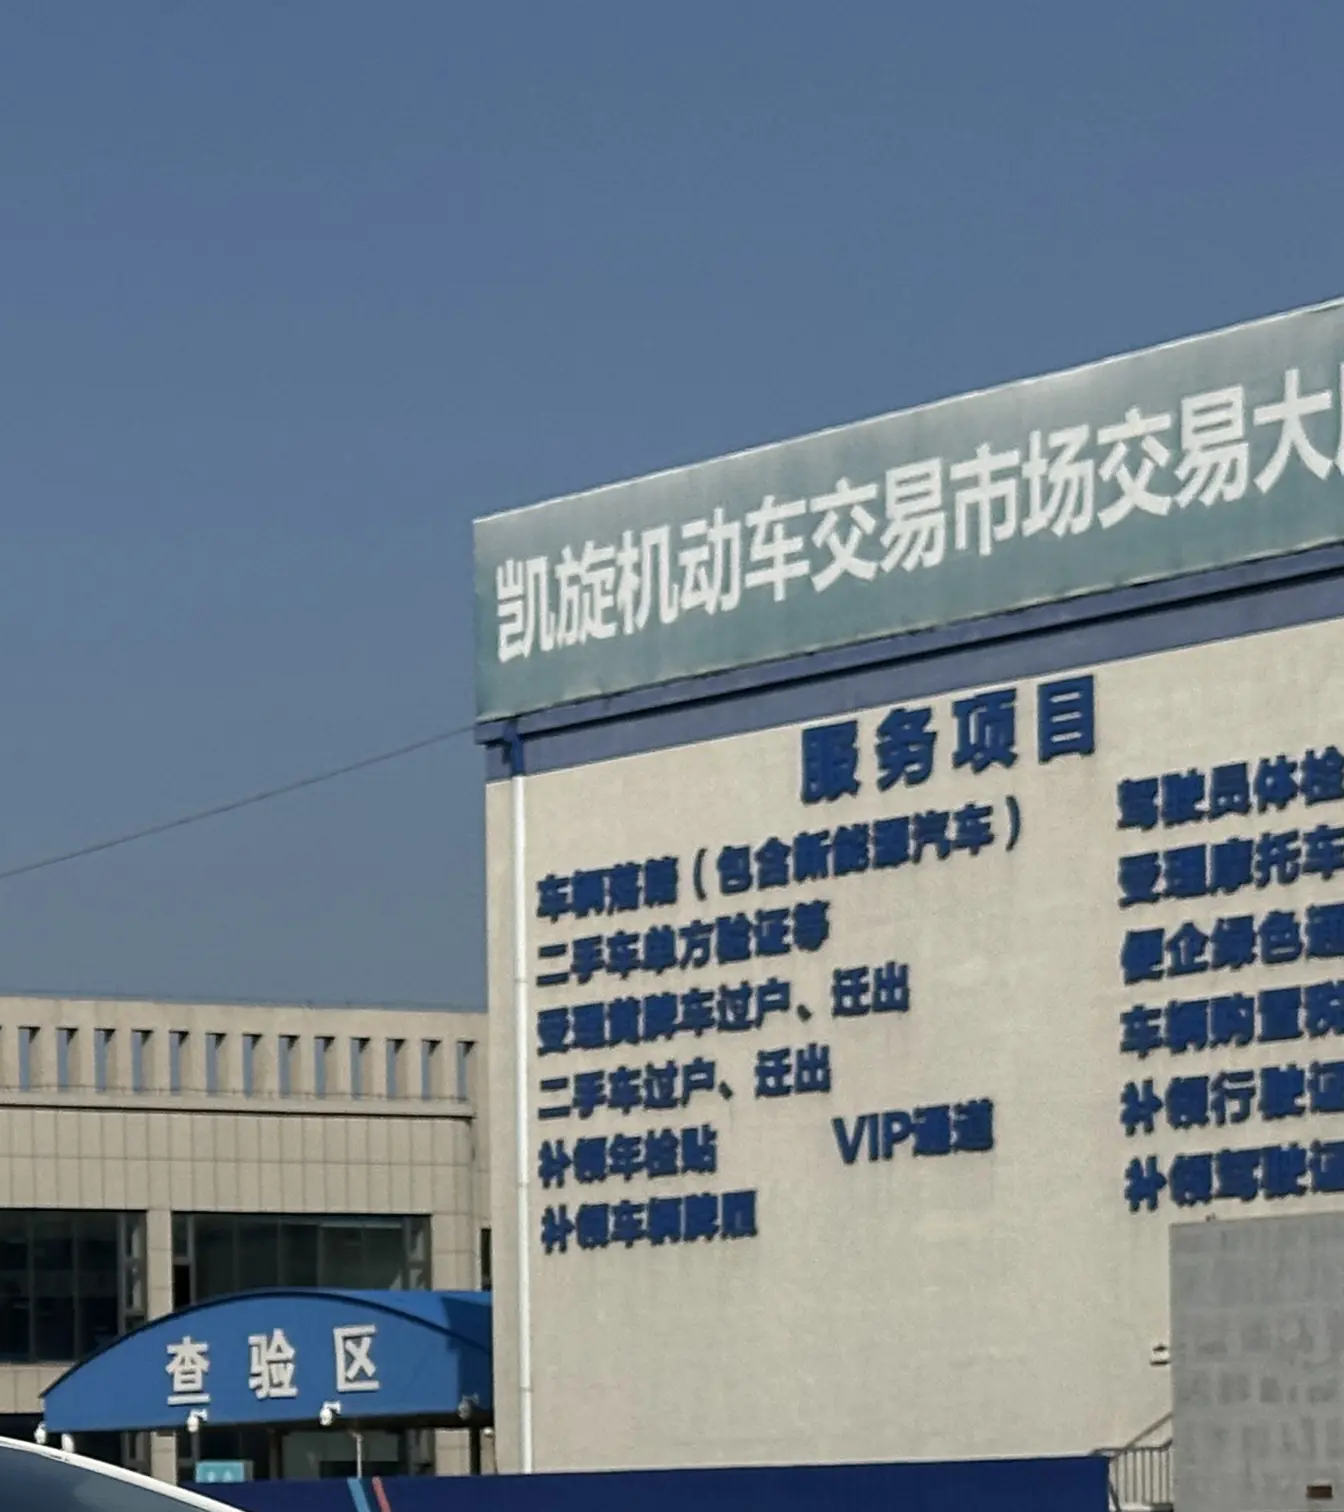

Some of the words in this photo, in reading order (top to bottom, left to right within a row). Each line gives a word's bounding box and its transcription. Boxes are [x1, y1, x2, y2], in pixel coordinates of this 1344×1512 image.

[496, 362, 1344, 663] 凯旋机动车交易市场交易大
[801, 675, 1096, 805] 服务项目
[1117, 745, 1344, 831] 驾驶员体检
[1118, 825, 1344, 909] 受理摩托车
[538, 1042, 830, 1119] 二手车过户、迁出
[538, 1123, 717, 1188] 补领年检贴
[831, 1097, 994, 1164] VIP通道
[165, 1323, 380, 1406] 查验区
